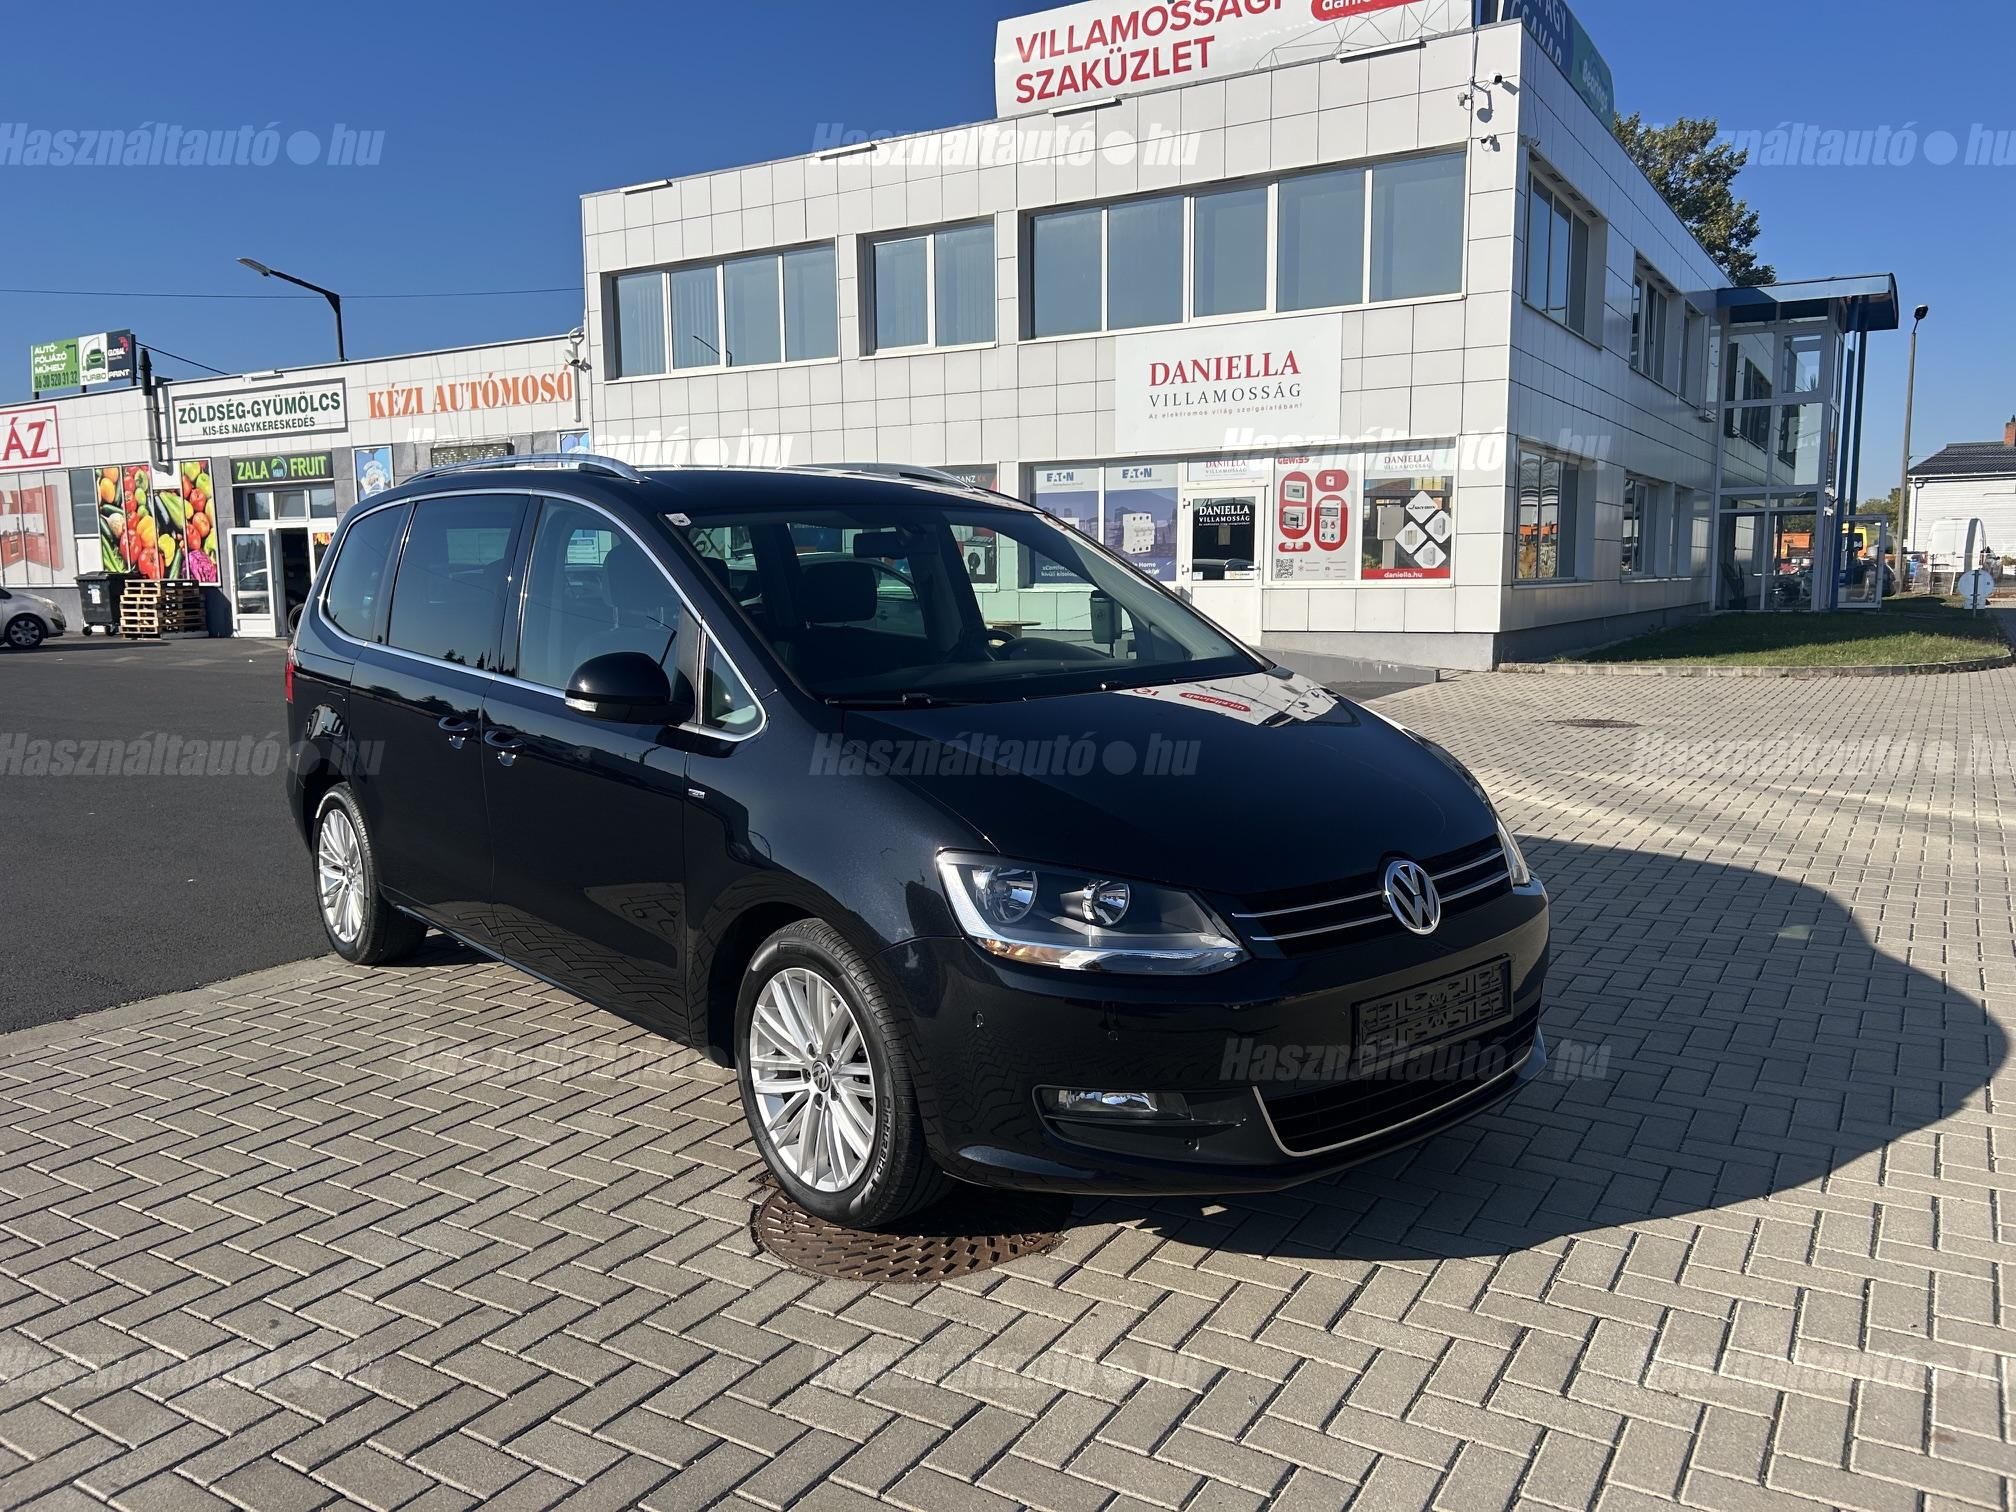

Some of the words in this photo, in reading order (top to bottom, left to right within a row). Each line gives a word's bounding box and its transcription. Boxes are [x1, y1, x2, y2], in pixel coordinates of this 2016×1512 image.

[1016, 36, 1215, 103] SZAKÜZLET
[81, 373, 106, 382] TURBO
[108, 369, 130, 378] PRINT
[1149, 350, 1301, 387] DANIELLA
[368, 382, 424, 418] KÉZI
[432, 364, 573, 413] AUTÓMOSÓ
[1149, 381, 1301, 408] VILLAMOSSÁG
[178, 391, 341, 424] ZÖLDSÉG-GYÜMÖLCS
[232, 416, 316, 433] NAGYKERESKEDÉS
[236, 461, 270, 480] ZALA
[290, 455, 327, 477] FRUIT
[1199, 505, 1249, 516] DANIELLA
[1199, 515, 1250, 523] VILLAMOSSÁG
